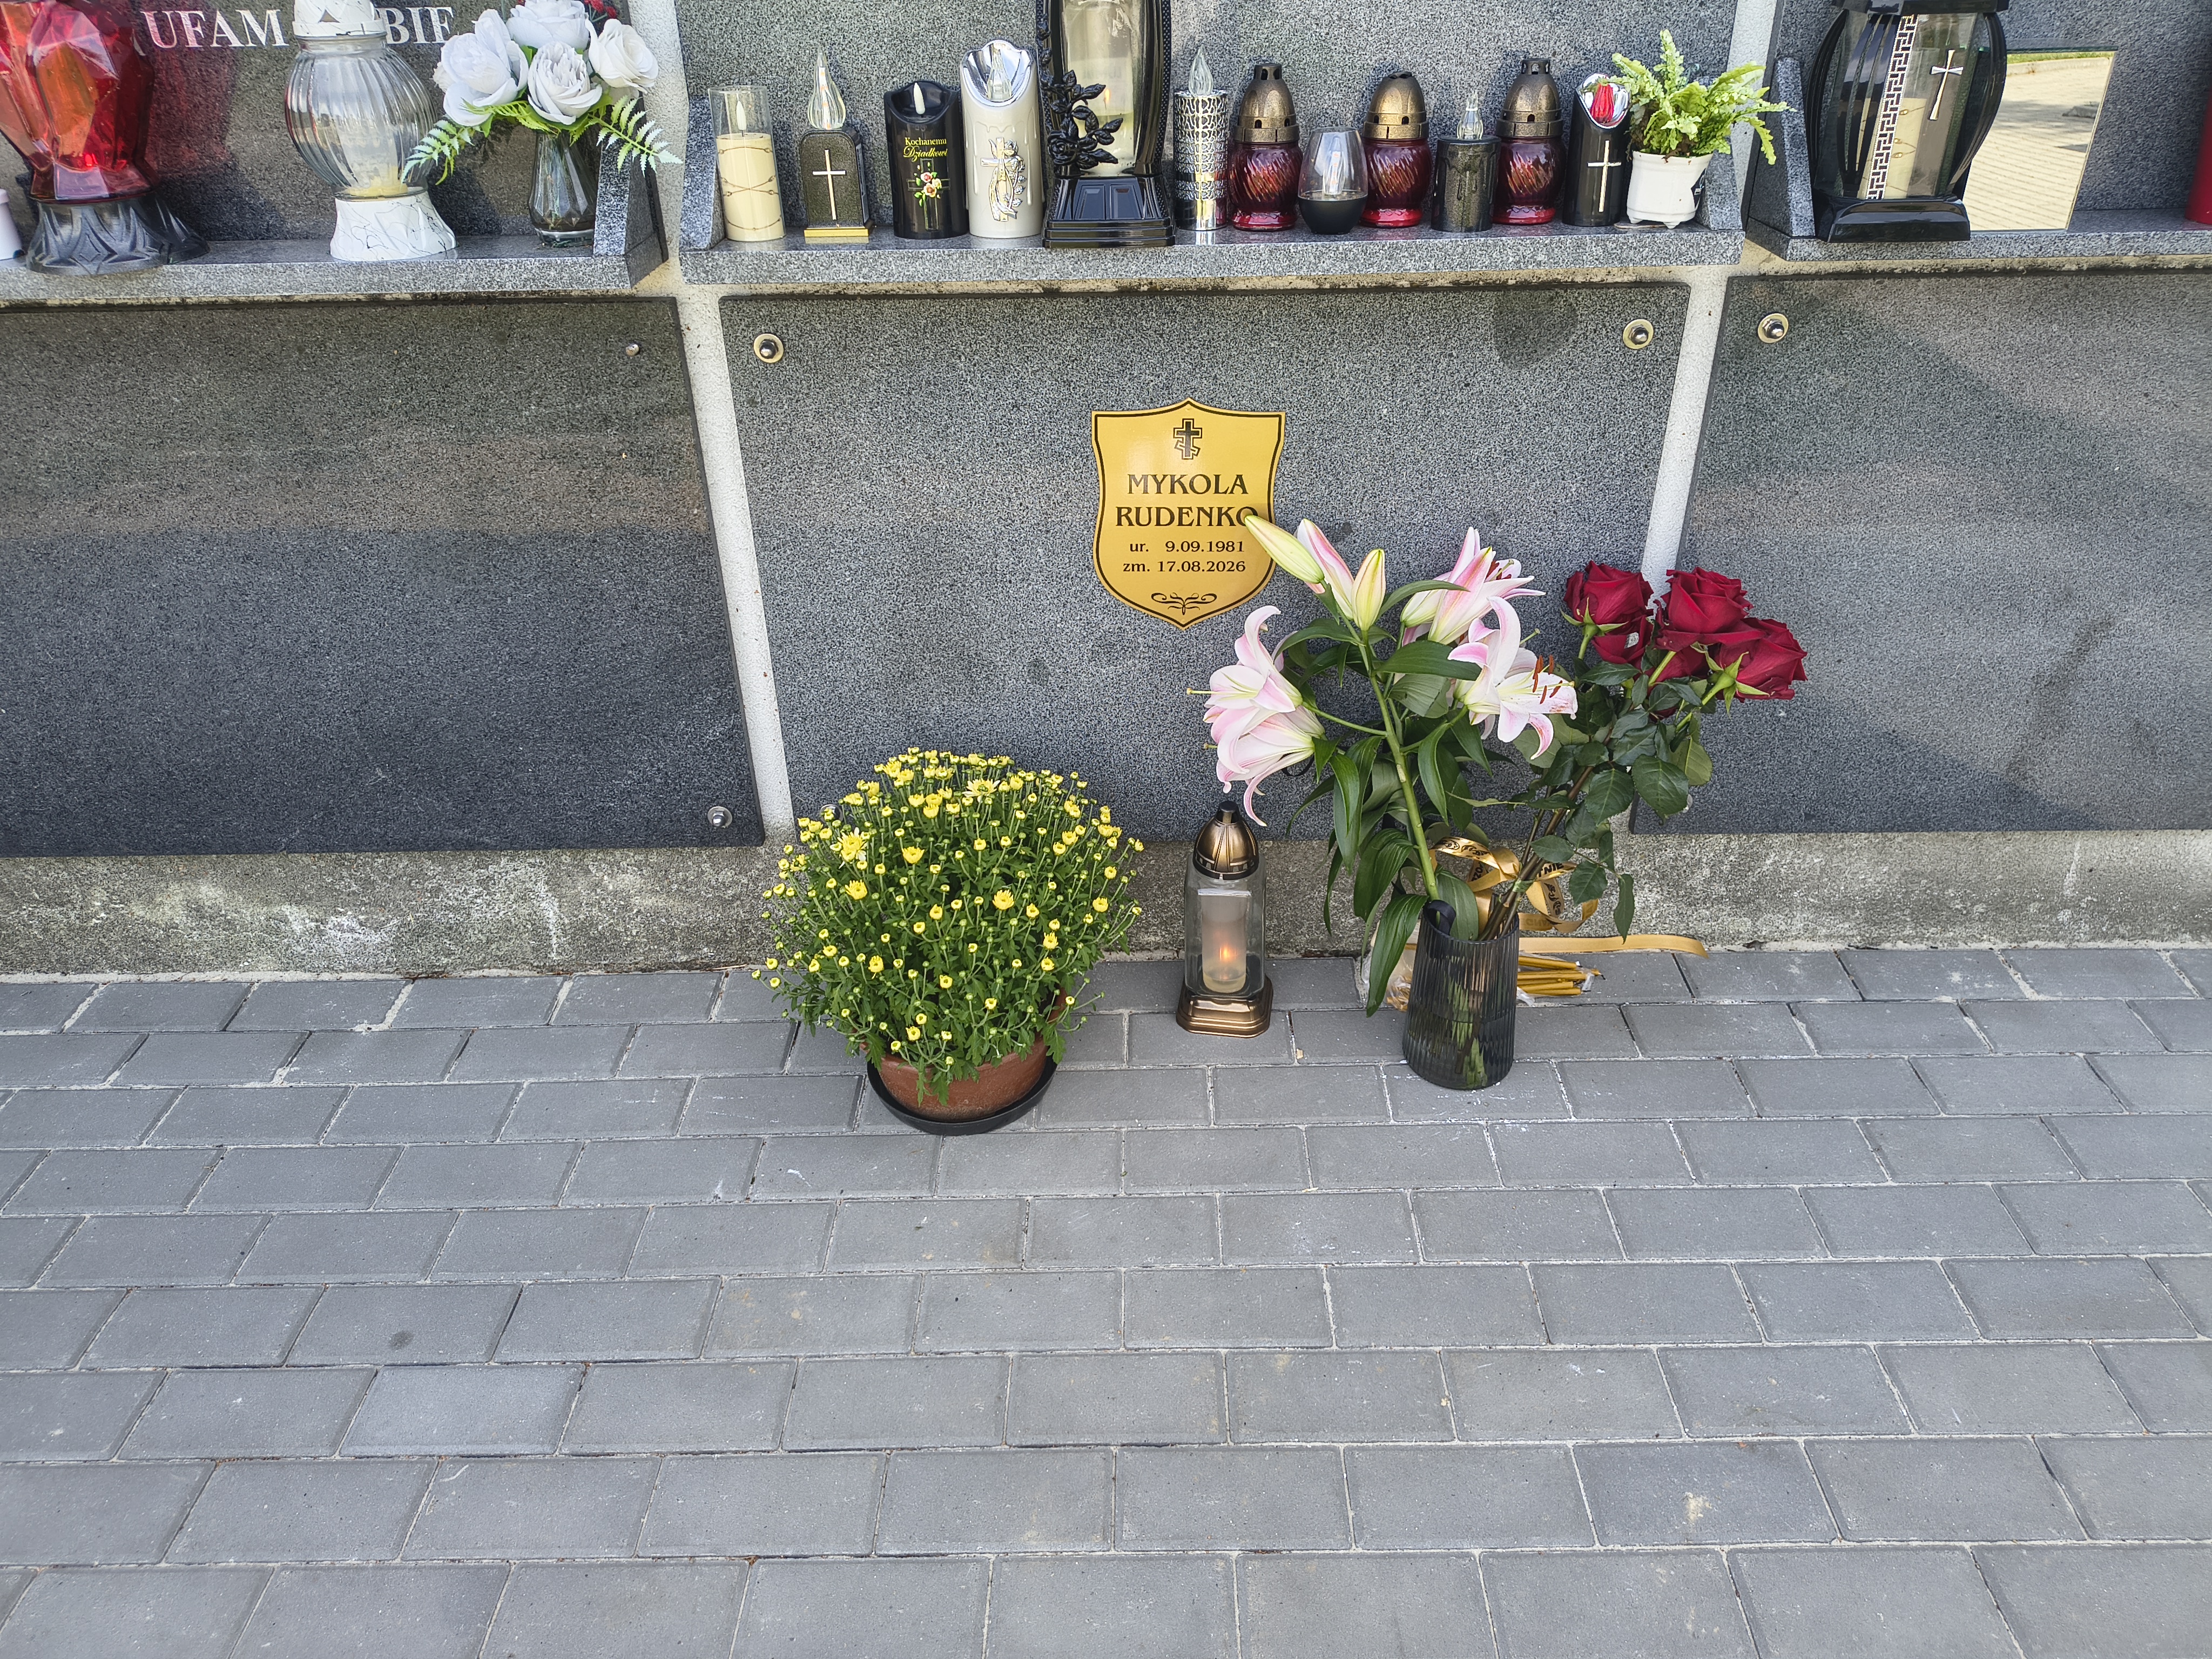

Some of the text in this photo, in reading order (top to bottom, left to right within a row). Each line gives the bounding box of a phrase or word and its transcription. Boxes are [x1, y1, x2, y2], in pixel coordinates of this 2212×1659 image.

[140, 9, 290, 48] UFAM
[374, 6, 454, 44] BIE
[904, 137, 947, 146] Kochanemu
[903, 145, 948, 162] Dziadkowi
[1128, 474, 1249, 495] MYKOLA
[1115, 506, 1258, 527] RUDENKO
[1130, 541, 1245, 552] ur. 9.09.1981
[1123, 561, 1246, 572] zm. 17.08.2026
